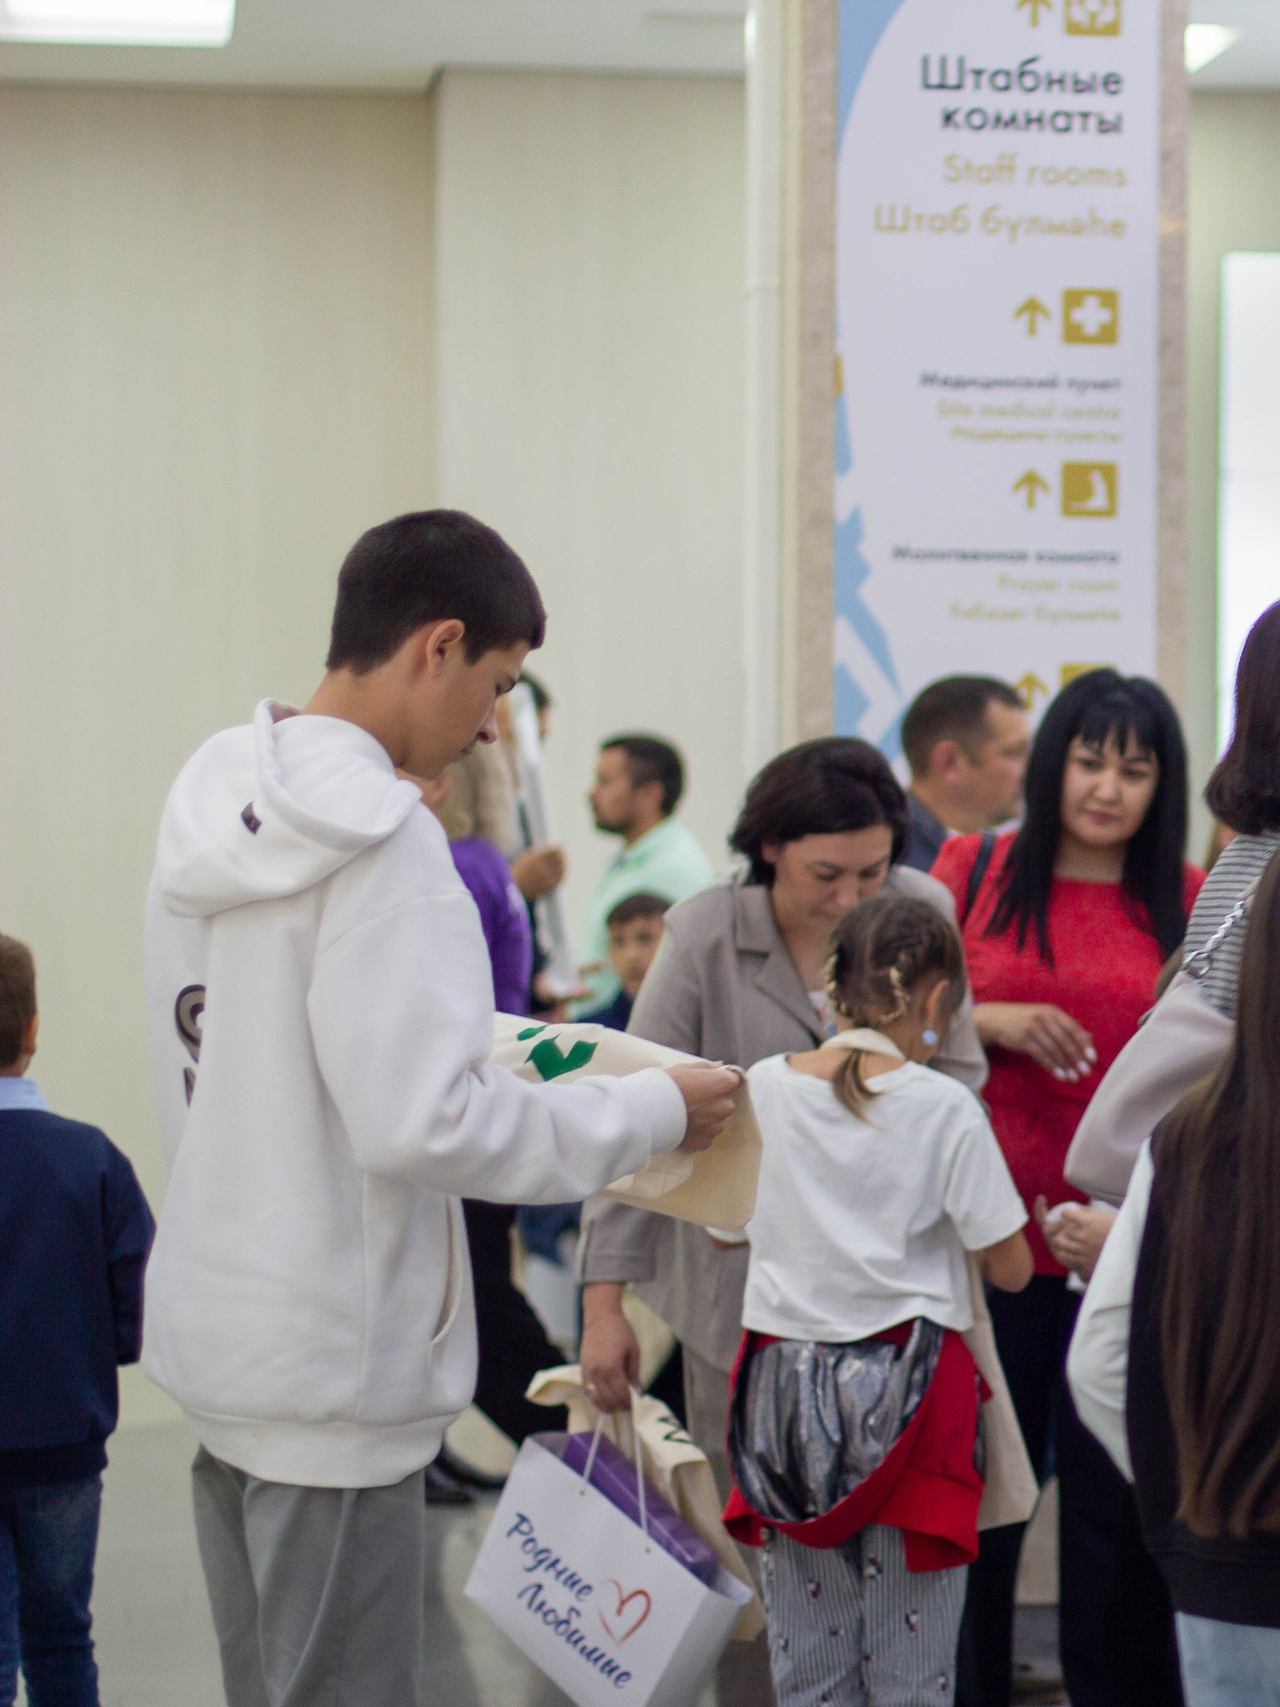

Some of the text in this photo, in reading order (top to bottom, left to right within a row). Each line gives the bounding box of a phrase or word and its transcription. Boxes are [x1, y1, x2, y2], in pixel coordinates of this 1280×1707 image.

[921, 54, 1122, 95] Штабные
[940, 106, 1122, 134] комнаты
[943, 152, 1127, 188] Staff rooms
[874, 203, 970, 234] Штаб
[505, 1511, 595, 1602] Родные
[516, 1582, 633, 1690] Любимые
